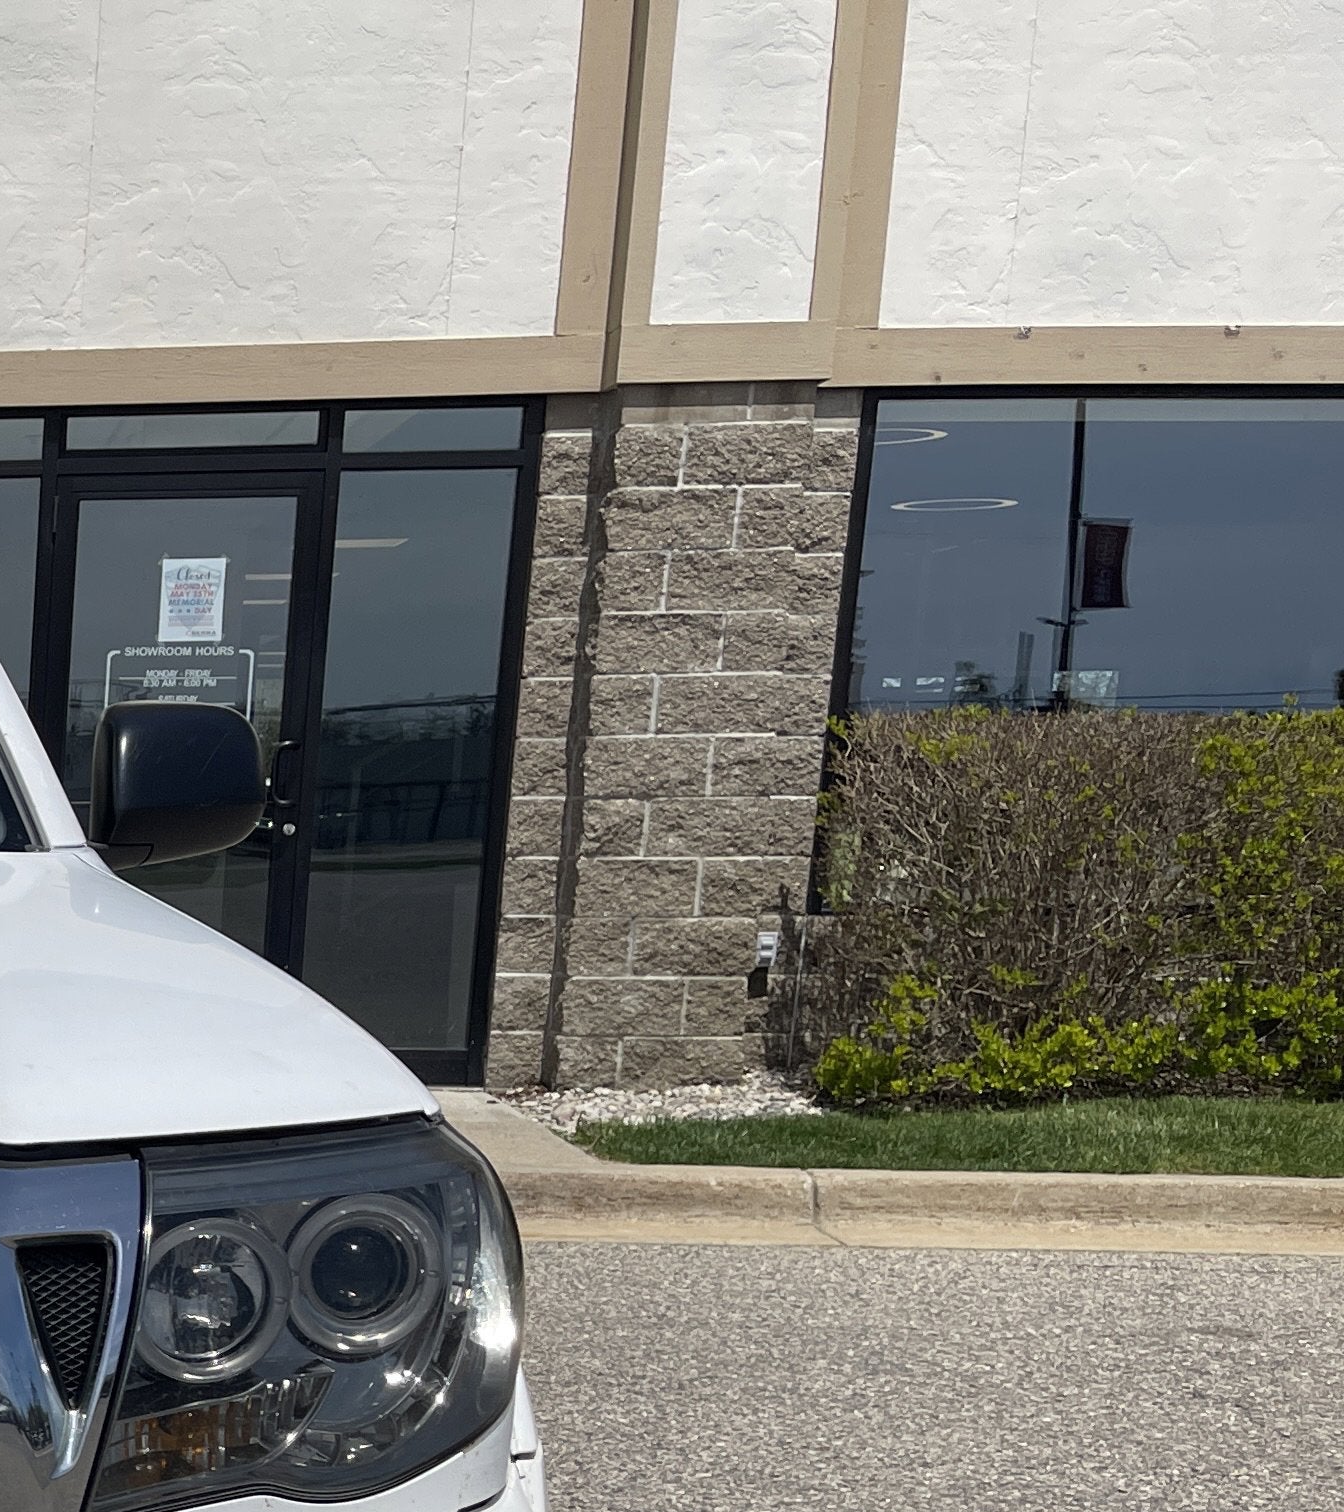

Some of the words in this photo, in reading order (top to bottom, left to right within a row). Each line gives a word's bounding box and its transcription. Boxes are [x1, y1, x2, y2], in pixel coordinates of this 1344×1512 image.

[124, 646, 192, 657] SHOWROOM
[195, 646, 235, 656] HOURS
[146, 669, 179, 678] MONDAY
[184, 669, 212, 678] FRIDAY
[161, 678, 177, 687] AM
[202, 678, 217, 687] PM
